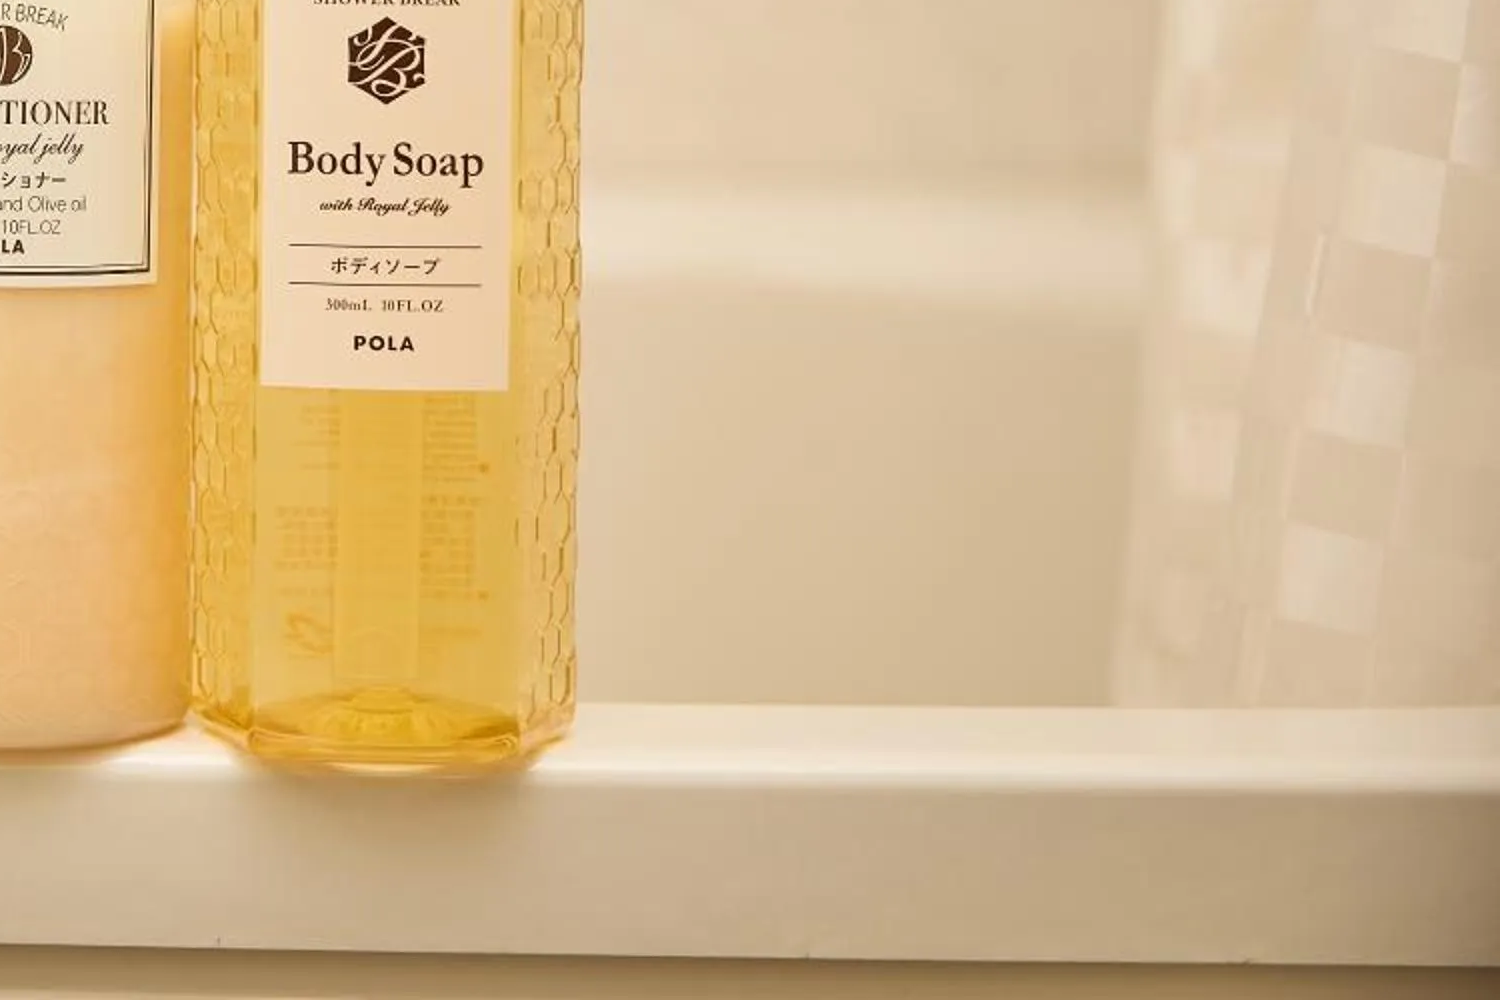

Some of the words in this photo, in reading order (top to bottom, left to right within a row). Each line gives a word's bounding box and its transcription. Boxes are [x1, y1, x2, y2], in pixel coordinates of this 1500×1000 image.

[15, 4, 69, 32] BREAK
[33, 134, 84, 164] jelly
[288, 141, 386, 186] Body
[394, 142, 484, 188] Soap
[27, 196, 66, 213] Olive
[70, 196, 87, 212] oil
[319, 198, 353, 212] with
[358, 197, 408, 216] Royal
[408, 198, 450, 217] Jelly
[325, 298, 373, 312] 300mL
[353, 335, 415, 352] POLA
